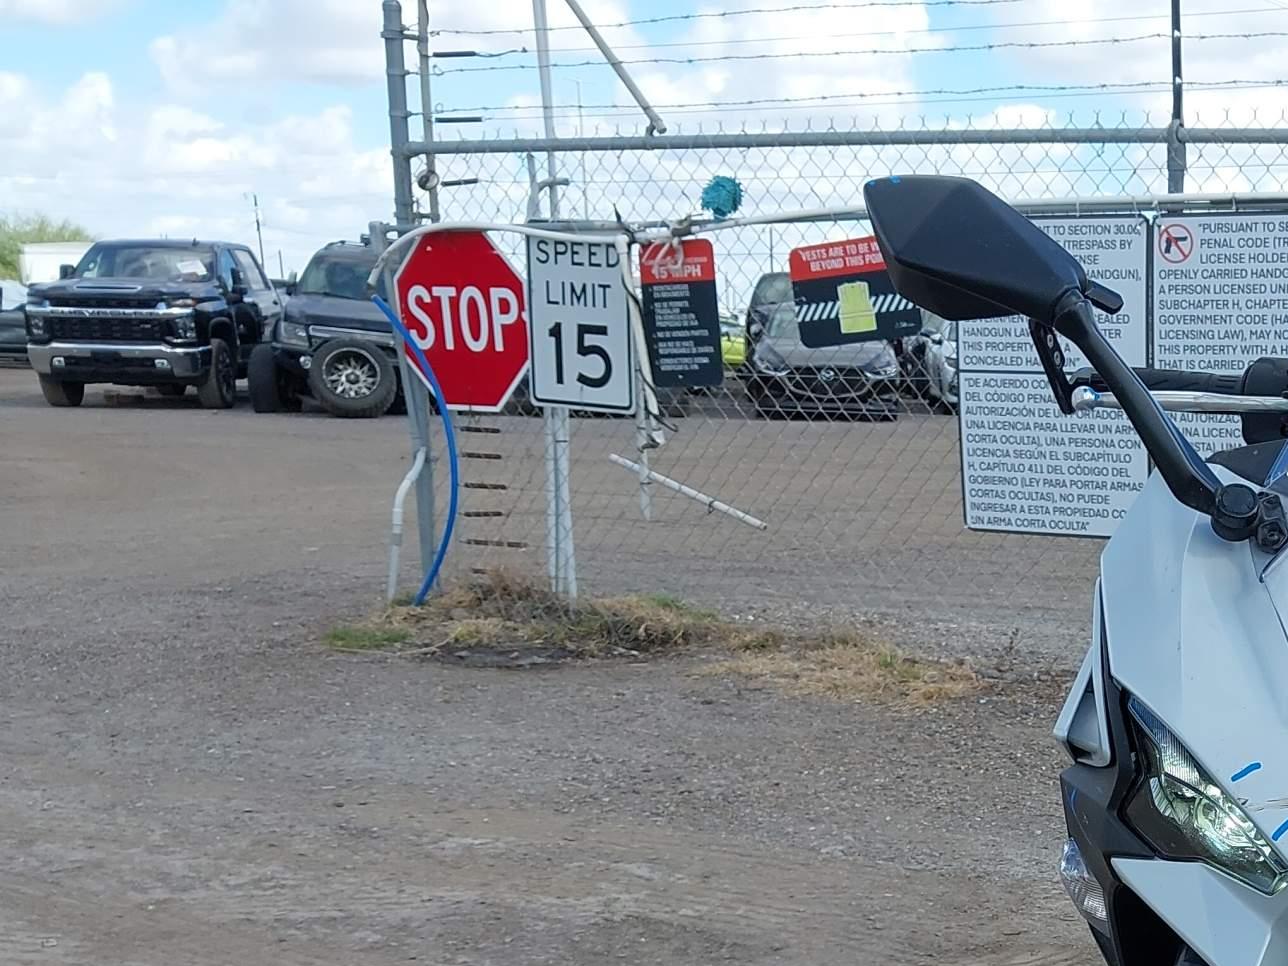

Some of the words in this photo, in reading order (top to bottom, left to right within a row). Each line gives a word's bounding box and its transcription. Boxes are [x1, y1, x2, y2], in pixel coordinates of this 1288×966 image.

[1053, 225, 1066, 235] TO
[1068, 224, 1111, 235] SECTION
[1262, 222, 1276, 233] TO
[1119, 240, 1132, 249] BY
[1200, 238, 1235, 249] PENAL
[1237, 238, 1270, 248] CODE
[536, 240, 620, 267] SPEED
[799, 249, 827, 261] VESTS
[828, 248, 844, 259] ARE
[846, 244, 857, 254] TO
[859, 243, 869, 253] BE
[810, 259, 844, 272] BEYOND
[846, 256, 864, 267] THIS
[1073, 254, 1100, 265] ENSE
[1200, 253, 1245, 264] LICENSE
[1159, 269, 1199, 279] OPENLY
[1201, 268, 1248, 279] CARRIED
[546, 280, 612, 308] LIMIT
[1159, 285, 1166, 294] A
[1168, 284, 1211, 294] PERSON
[1213, 284, 1266, 294] LICENSED
[1159, 300, 1229, 310] SUBCHAPTER
[1231, 300, 1242, 311] H,
[407, 285, 519, 352] STOP
[1097, 315, 1130, 324] EALED
[1159, 315, 1233, 325] GOVERNMENT
[1236, 314, 1268, 325] CODE
[963, 328, 1012, 337] HANDGUN
[1106, 329, 1122, 339] TER
[1159, 330, 1214, 340] LICENSING
[1217, 329, 1247, 342] LAW),
[1250, 329, 1272, 340] MAY
[963, 342, 983, 351] THIS
[985, 343, 1034, 352] PROPERTY
[1064, 344, 1071, 352] A
[1159, 344, 1180, 355] THIS
[1183, 344, 1238, 355] PROPERTY
[1240, 344, 1268, 354] WITH
[1270, 345, 1279, 354] A
[548, 322, 612, 388] 15
[964, 356, 1023, 366] CONCEALED
[1159, 360, 1183, 370] THAT
[1185, 360, 1195, 370] IS
[1197, 360, 1245, 370] CARRIED
[982, 378, 1029, 389] ACUERDO
[965, 392, 981, 402] DEL
[983, 391, 1025, 403] CÓDIGO
[965, 404, 1036, 417] AUTORIZACIÓN
[1038, 408, 1051, 417] DE
[1180, 413, 1240, 424] AUTORIZAC
[966, 420, 986, 430] UNA
[988, 421, 1032, 431] LICENCIA
[1034, 422, 1058, 432] PARA
[1060, 423, 1096, 433] LLEVAR
[1098, 424, 1112, 434] UN
[1114, 425, 1137, 434] ARM
[1202, 428, 1241, 437] LICENC
[966, 434, 998, 444] CORTA
[1000, 435, 1044, 447] OCULTA),
[1045, 437, 1066, 447] UNA
[1069, 438, 1116, 449] PERSONA
[1120, 440, 1141, 449] CON
[967, 448, 1011, 457] LICENCIA
[1013, 448, 1046, 460] SEGÚN
[1050, 452, 1062, 461] EL
[1063, 451, 1132, 463] SUBCAPÍTULO
[968, 462, 977, 472] H,
[979, 461, 1025, 472] CAPÍTULO
[1027, 464, 1044, 474] 411
[1047, 465, 1065, 475] DEL
[1067, 465, 1109, 477] CÓDIGO
[1112, 468, 1131, 478] DEL
[969, 475, 1018, 486] GOBIERNO
[1021, 477, 1041, 488] (LEY
[1043, 479, 1067, 489] PARA
[1070, 480, 1108, 490] PORTAR
[969, 489, 1007, 499] CORTAS
[1009, 490, 1057, 503] OCULTAS),
[1060, 493, 1074, 503] NO
[1077, 494, 1110, 504] PUEDE
[971, 502, 1017, 513] INGRESAR
[1019, 504, 1026, 513] A
[1028, 505, 1050, 515] ESTA
[1053, 507, 1109, 518] PROPIEDAD
[1112, 509, 1126, 519] CO
[986, 517, 1013, 527] ARMA
[1016, 518, 1047, 529] CORTA
